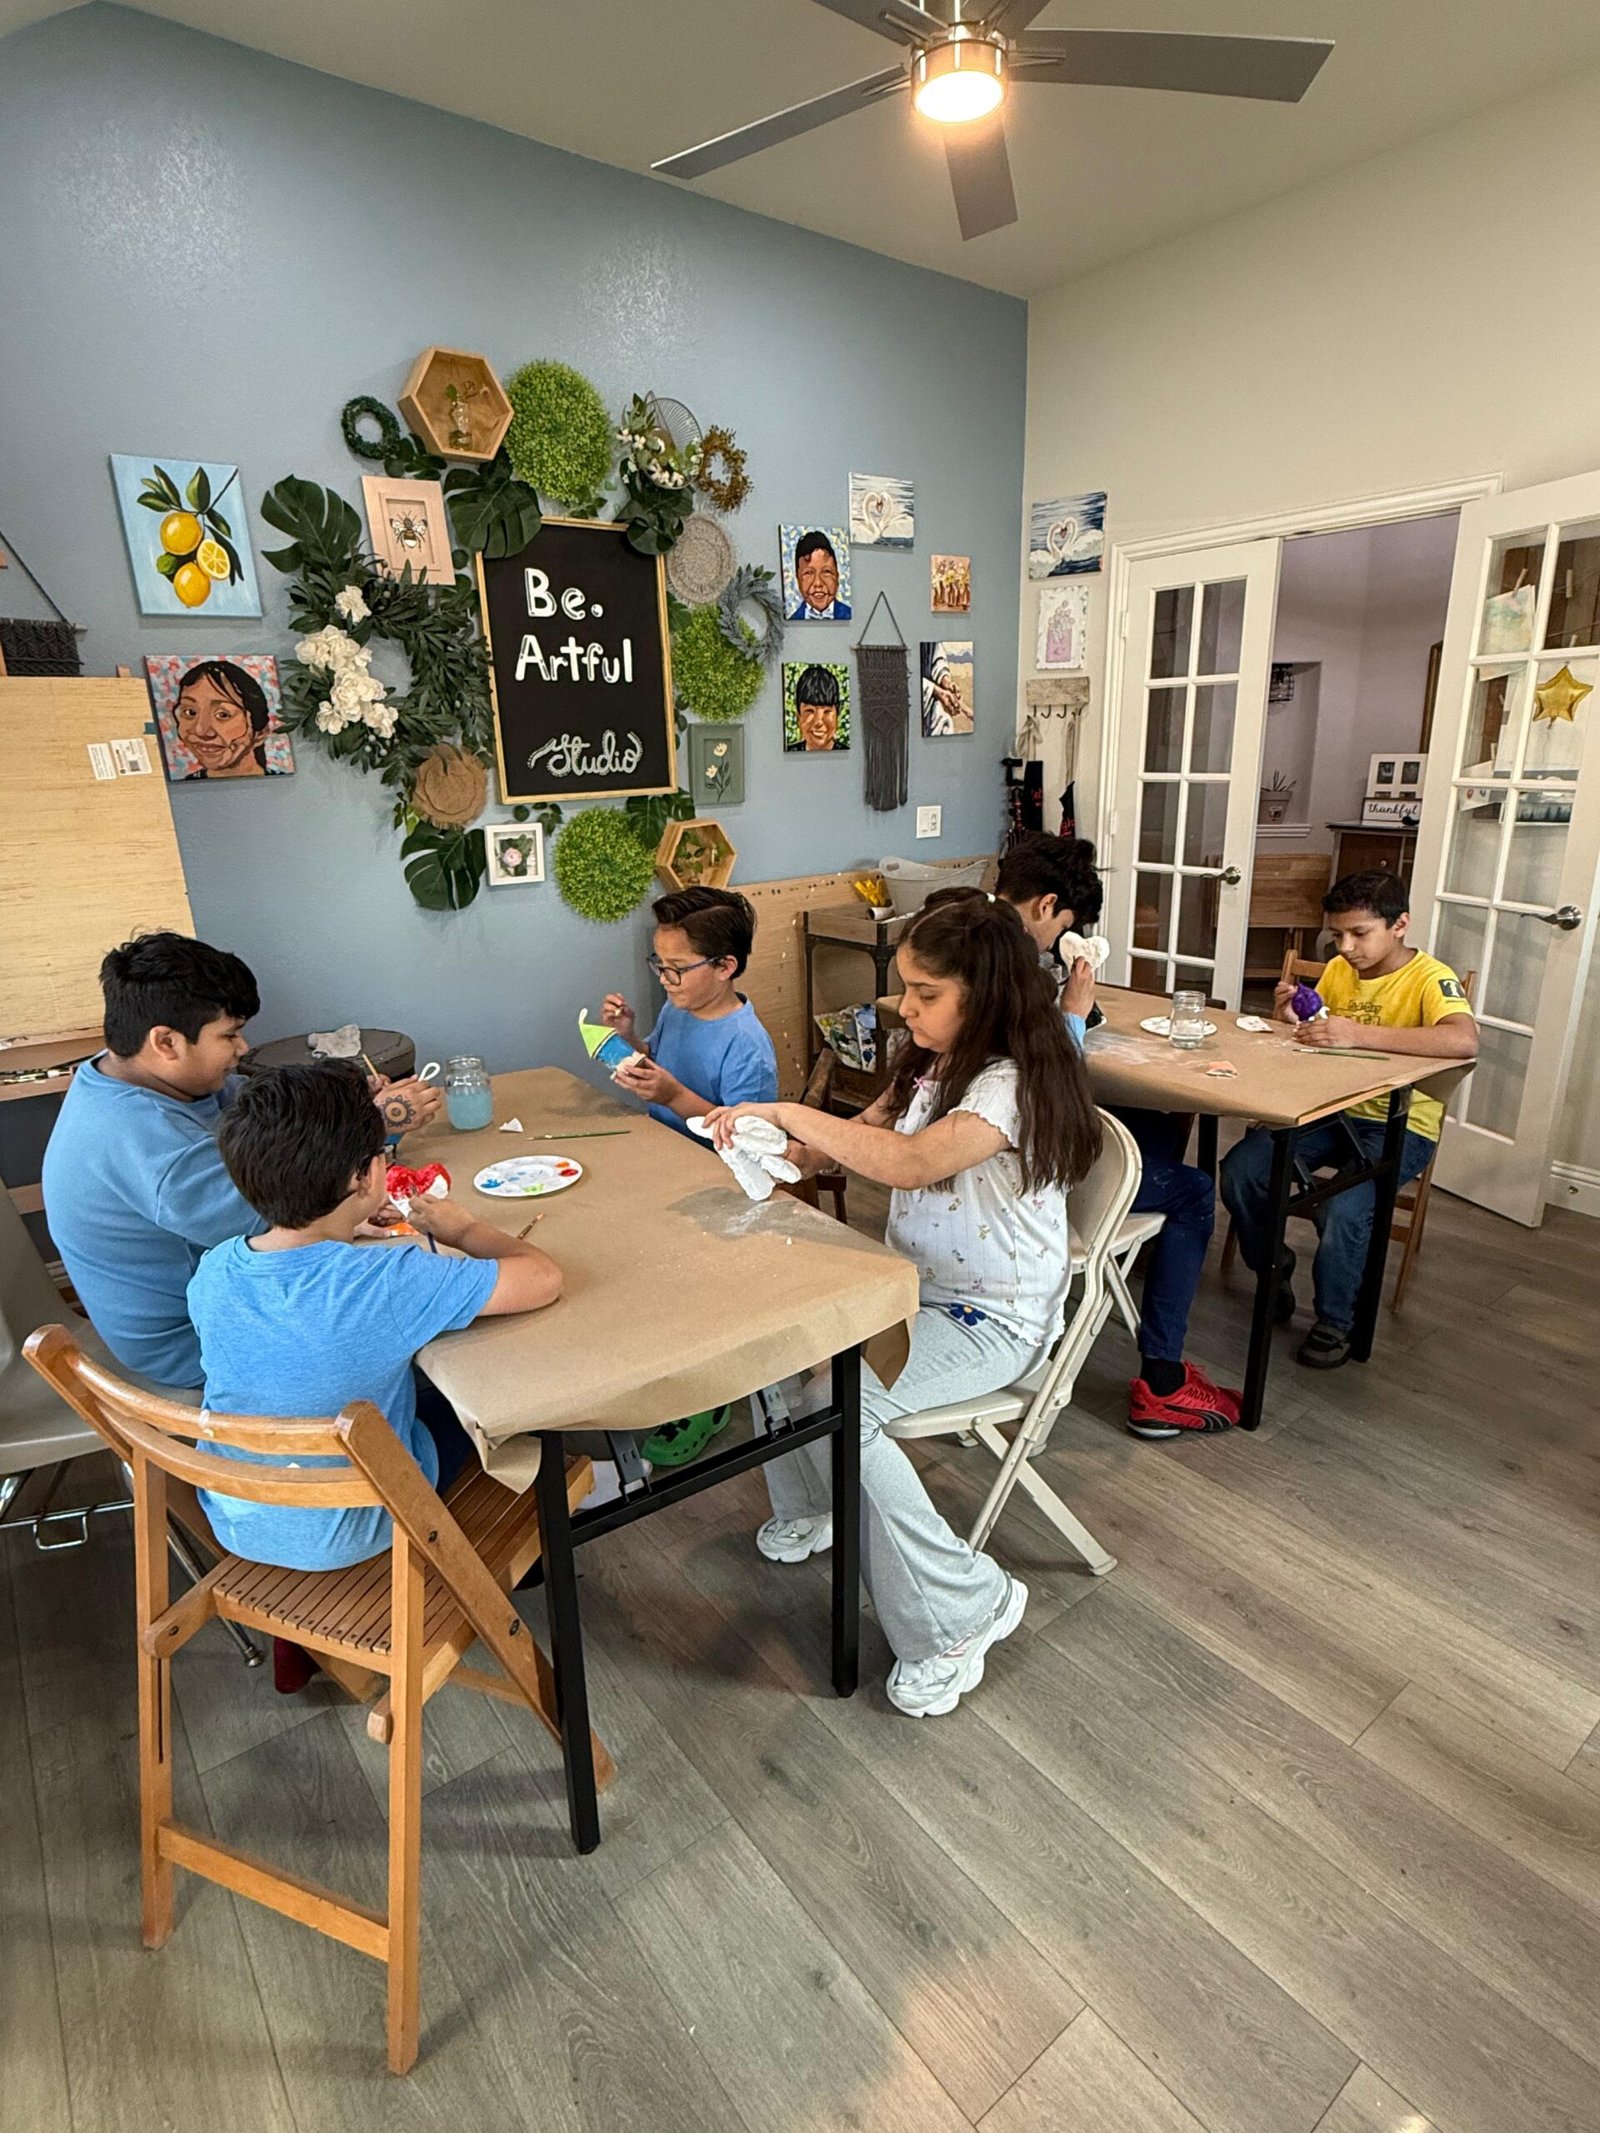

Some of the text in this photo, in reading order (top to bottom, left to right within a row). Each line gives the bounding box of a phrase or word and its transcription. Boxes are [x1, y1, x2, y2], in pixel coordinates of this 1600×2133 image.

[524, 567, 604, 621] Be.
[514, 634, 633, 684] Artful
[526, 729, 644, 778] Studio
[1368, 803, 1419, 818] thankful
